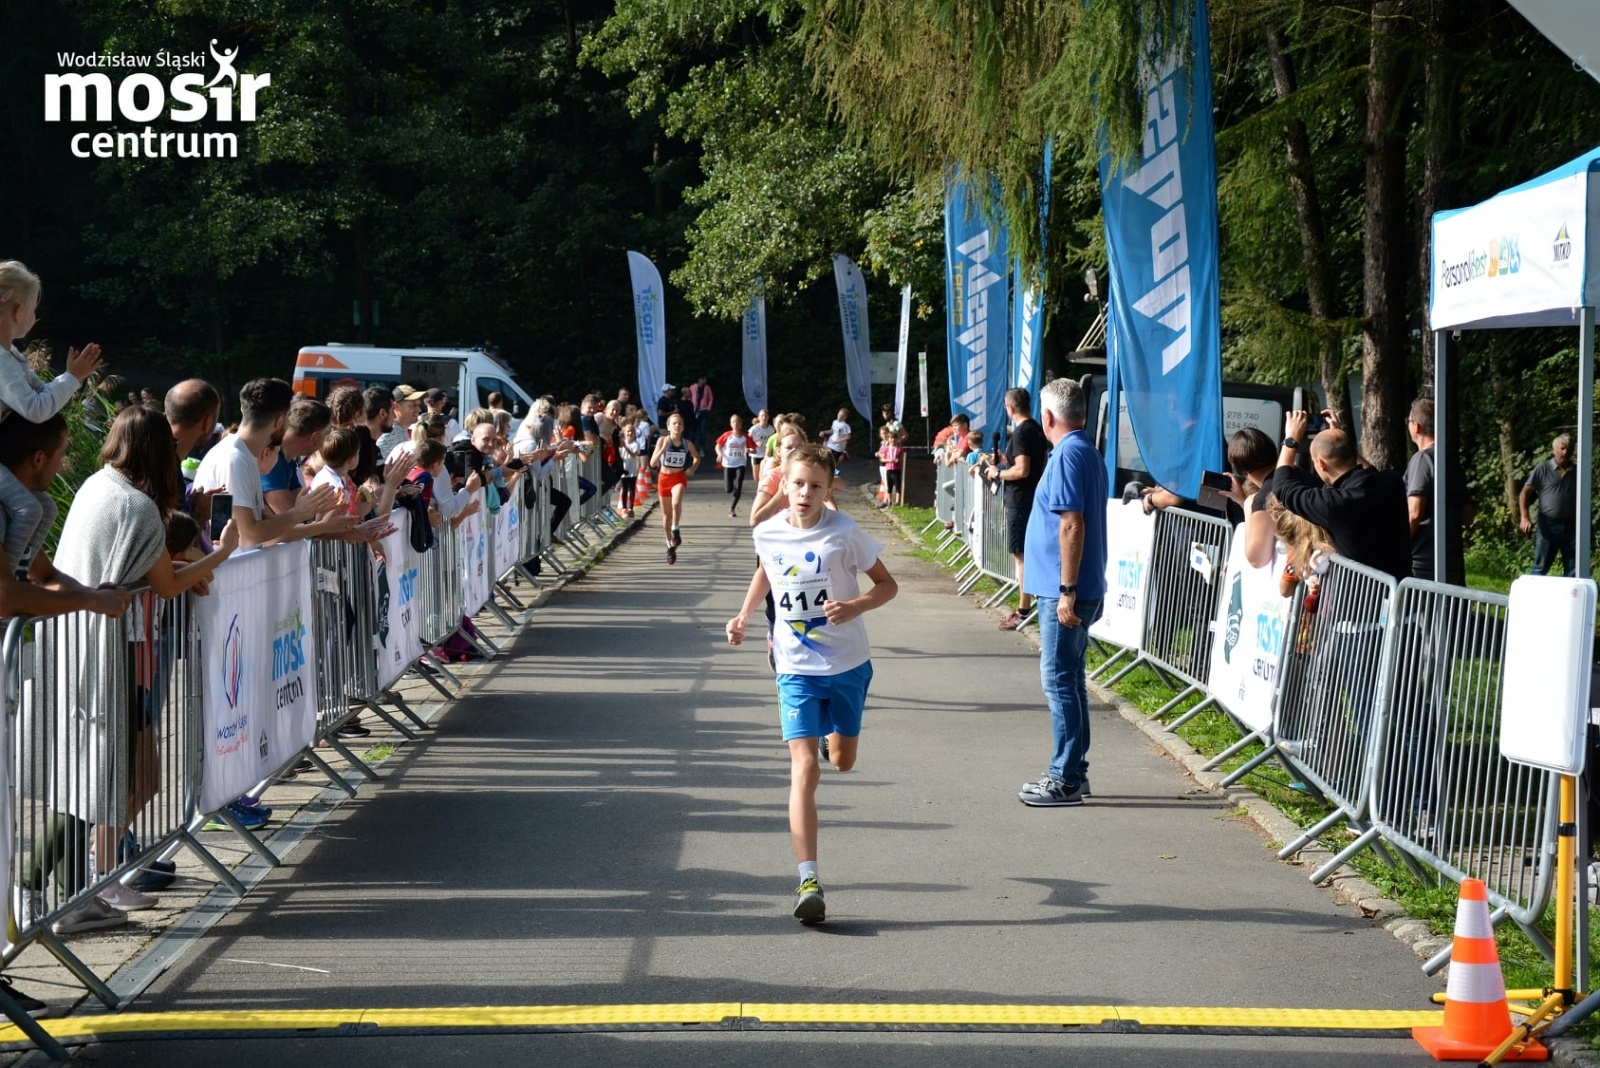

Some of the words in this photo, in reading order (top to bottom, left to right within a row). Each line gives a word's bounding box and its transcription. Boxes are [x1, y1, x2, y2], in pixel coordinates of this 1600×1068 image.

[1244, 412, 1260, 420] 740
[666, 457, 684, 465] 425
[780, 588, 828, 611] 414
